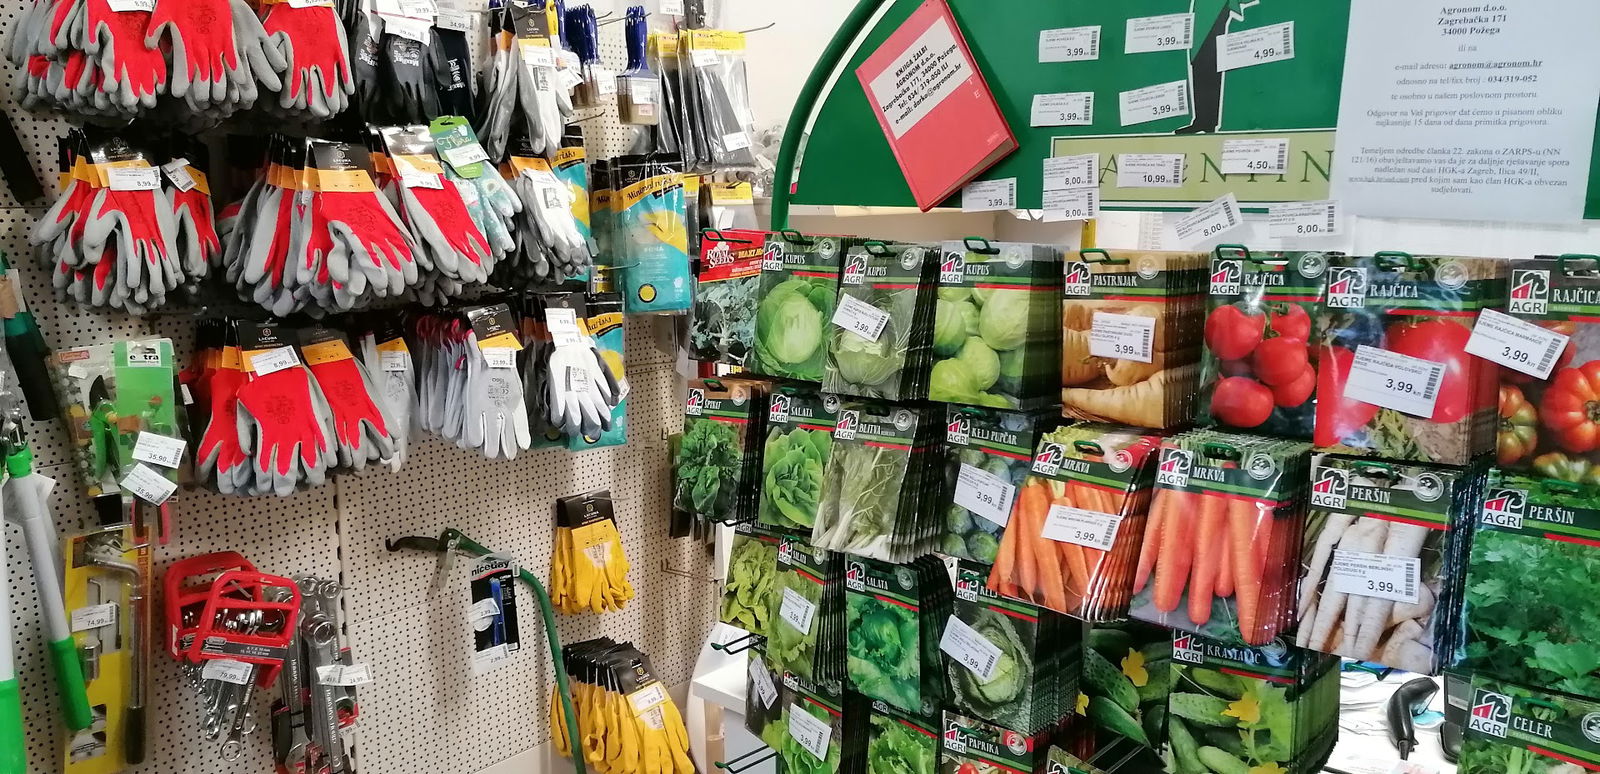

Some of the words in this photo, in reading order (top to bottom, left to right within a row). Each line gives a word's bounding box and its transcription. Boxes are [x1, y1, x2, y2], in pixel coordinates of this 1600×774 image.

[1440, 7, 1481, 15] Agronom
[1483, 4, 1508, 12] d.o.o.
[1437, 15, 1490, 26] Zagrebačka
[1492, 14, 1507, 22] 171
[1441, 27, 1468, 36] 34000
[1470, 26, 1501, 35] Požega
[1156, 36, 1176, 47] 3,99
[1066, 47, 1084, 58] 3,99
[1254, 47, 1275, 60] 4,99
[895, 59, 914, 78] KNJIGA
[912, 45, 928, 62] ŽALBI
[1395, 63, 1419, 71] e-mail
[1449, 59, 1544, 70] agronom@agronom.hr
[895, 63, 921, 89] AGRONOM
[920, 52, 936, 67] d.o.o.
[921, 60, 938, 78] 34000
[1396, 77, 1428, 86] odnosno
[1488, 74, 1538, 84] 034/319-052
[897, 99, 909, 110] Tel:
[919, 69, 942, 91] 319-050
[1397, 92, 1427, 100] osobno
[1435, 91, 1458, 100] našem
[1459, 90, 1502, 101] poslovnom
[1152, 104, 1171, 116] 3,99
[1367, 109, 1398, 118] Odgovor
[1424, 109, 1457, 119] prigovor
[1502, 107, 1535, 117] pisanom
[1537, 107, 1563, 116] obliku
[1060, 113, 1077, 122] 3,99
[1474, 118, 1507, 127] primitka
[1361, 147, 1395, 156] Temeljem
[1396, 147, 1425, 155] odredbe
[1466, 147, 1493, 155] zakona
[1502, 147, 1541, 156] ZARPS-u
[1247, 160, 1268, 171] 4,50
[1478, 158, 1505, 167] daljnje
[1548, 160, 1570, 168] spora
[1407, 166, 1420, 174] sud
[1438, 166, 1466, 175] HGK-a
[1065, 176, 1082, 186] 8,00
[1143, 174, 1166, 184] 10,99
[1411, 176, 1428, 185] pred
[1429, 176, 1451, 186] kojim
[1470, 177, 1484, 185] kao
[1503, 177, 1532, 186] HGK-a
[1534, 178, 1568, 187] obvezan
[988, 198, 1003, 208] 3,99
[1065, 209, 1082, 218] 8,00
[1203, 222, 1222, 238] 8,00
[1296, 223, 1318, 234] 8,00
[706, 249, 729, 261] ROYAL
[708, 253, 735, 269] SEEDS
[785, 254, 805, 265] KUPUS
[763, 262, 783, 270] AGRI
[867, 266, 887, 277] KUPUS
[966, 264, 990, 276] KUPUS
[843, 275, 863, 284] AGRI
[940, 274, 963, 283] AGRI
[1093, 274, 1138, 288] PASTRNJAK
[1244, 271, 1285, 286] RAJČICA
[1065, 285, 1090, 295] AGRI
[1210, 284, 1240, 294] AGRI
[1370, 282, 1418, 298] RAJČICA
[1329, 297, 1364, 307] AGRI
[1511, 302, 1547, 313] AGRI
[854, 320, 869, 333] 3,99
[1115, 344, 1134, 355] 3,99
[1502, 346, 1529, 363] 3,99
[1526, 360, 1536, 368] kn
[1385, 378, 1413, 393] 3,99
[686, 405, 702, 415] AGRI
[790, 406, 813, 418] SALATA
[770, 412, 788, 422] AGRI
[835, 429, 855, 440] AGRI
[858, 424, 881, 435] BLITVA
[948, 433, 969, 446] AGRI
[971, 427, 991, 441] KELJ
[991, 431, 1018, 446] PUPČAR
[1032, 463, 1058, 476] AGRI
[1062, 458, 1091, 474] MRKVA
[1158, 472, 1188, 486] AGRI
[1193, 466, 1226, 483] MRKVA
[976, 491, 993, 505] 3,99
[1351, 484, 1391, 504] PERŠIN
[1312, 494, 1346, 509] AGRI
[1482, 512, 1523, 528] AGRI
[1529, 504, 1576, 525] PERŠIN
[1075, 530, 1095, 542] 3,99
[471, 560, 511, 577] niceday
[847, 580, 865, 592] AGRI
[866, 576, 889, 590] SALATA
[1367, 579, 1394, 593] 3,99
[956, 590, 978, 603] AGRI
[963, 653, 979, 669] 3,99
[1174, 651, 1203, 664] AGRI
[1470, 720, 1507, 737] AGRI
[1513, 716, 1553, 739] CELER
[945, 741, 967, 754] AGRI
[968, 737, 1000, 755] PAPRIKA
